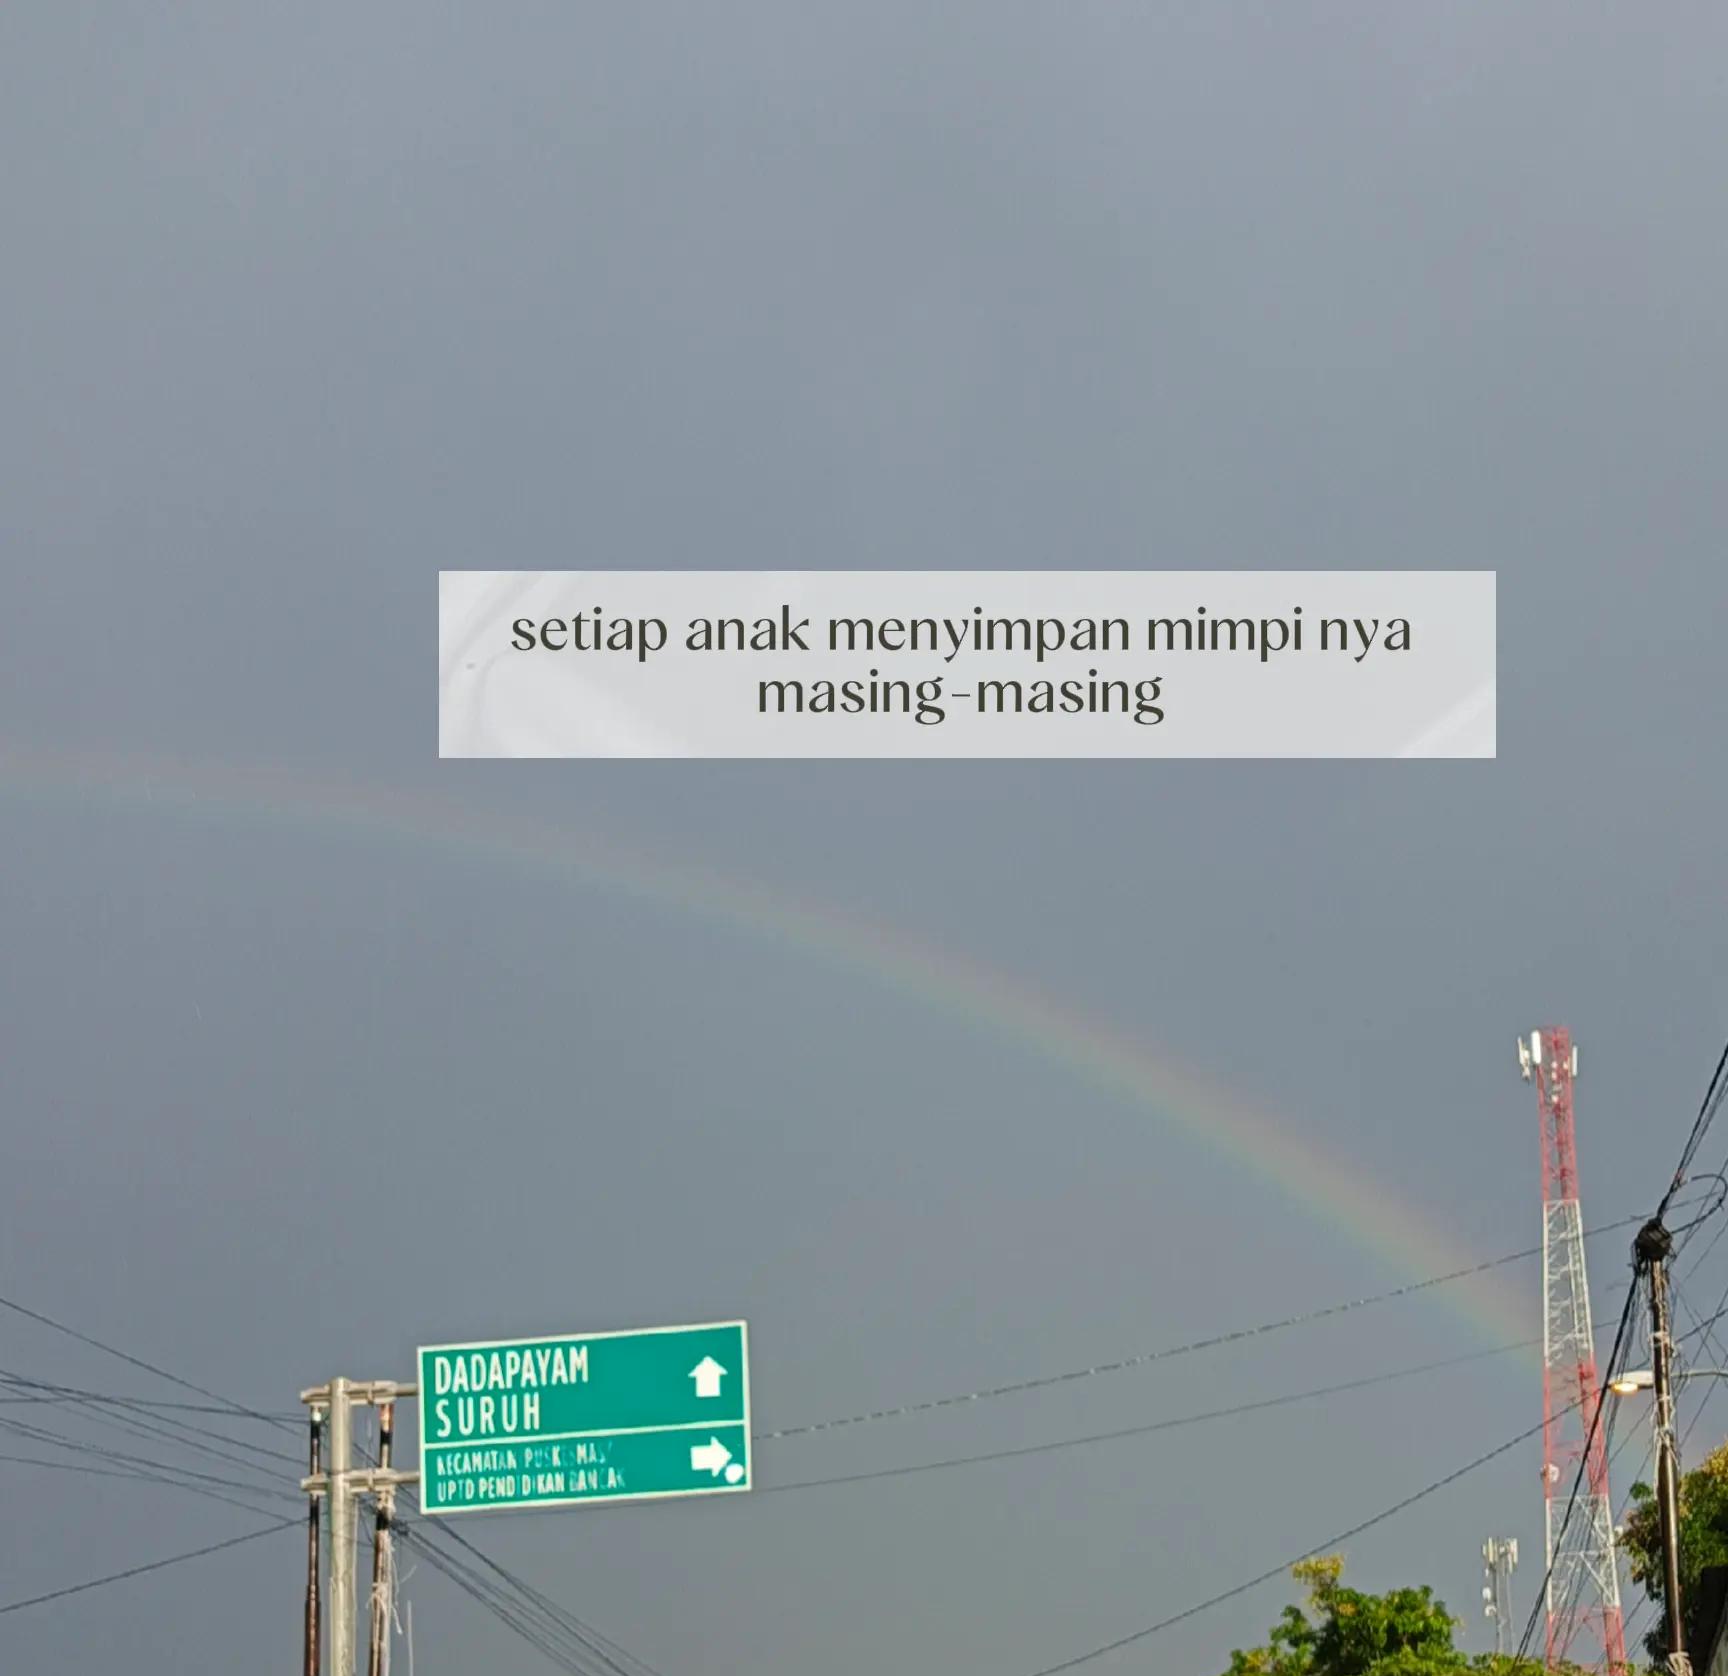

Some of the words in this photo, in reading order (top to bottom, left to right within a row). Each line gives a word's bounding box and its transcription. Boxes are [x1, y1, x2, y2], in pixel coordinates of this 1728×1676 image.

[434, 1345, 589, 1396] DADAPAYAM
[435, 1392, 540, 1438] SURUH
[437, 1449, 517, 1476] KECAMATAN
[437, 1475, 475, 1502] UPTD
[478, 1471, 565, 1499] PENDIDIKAN
